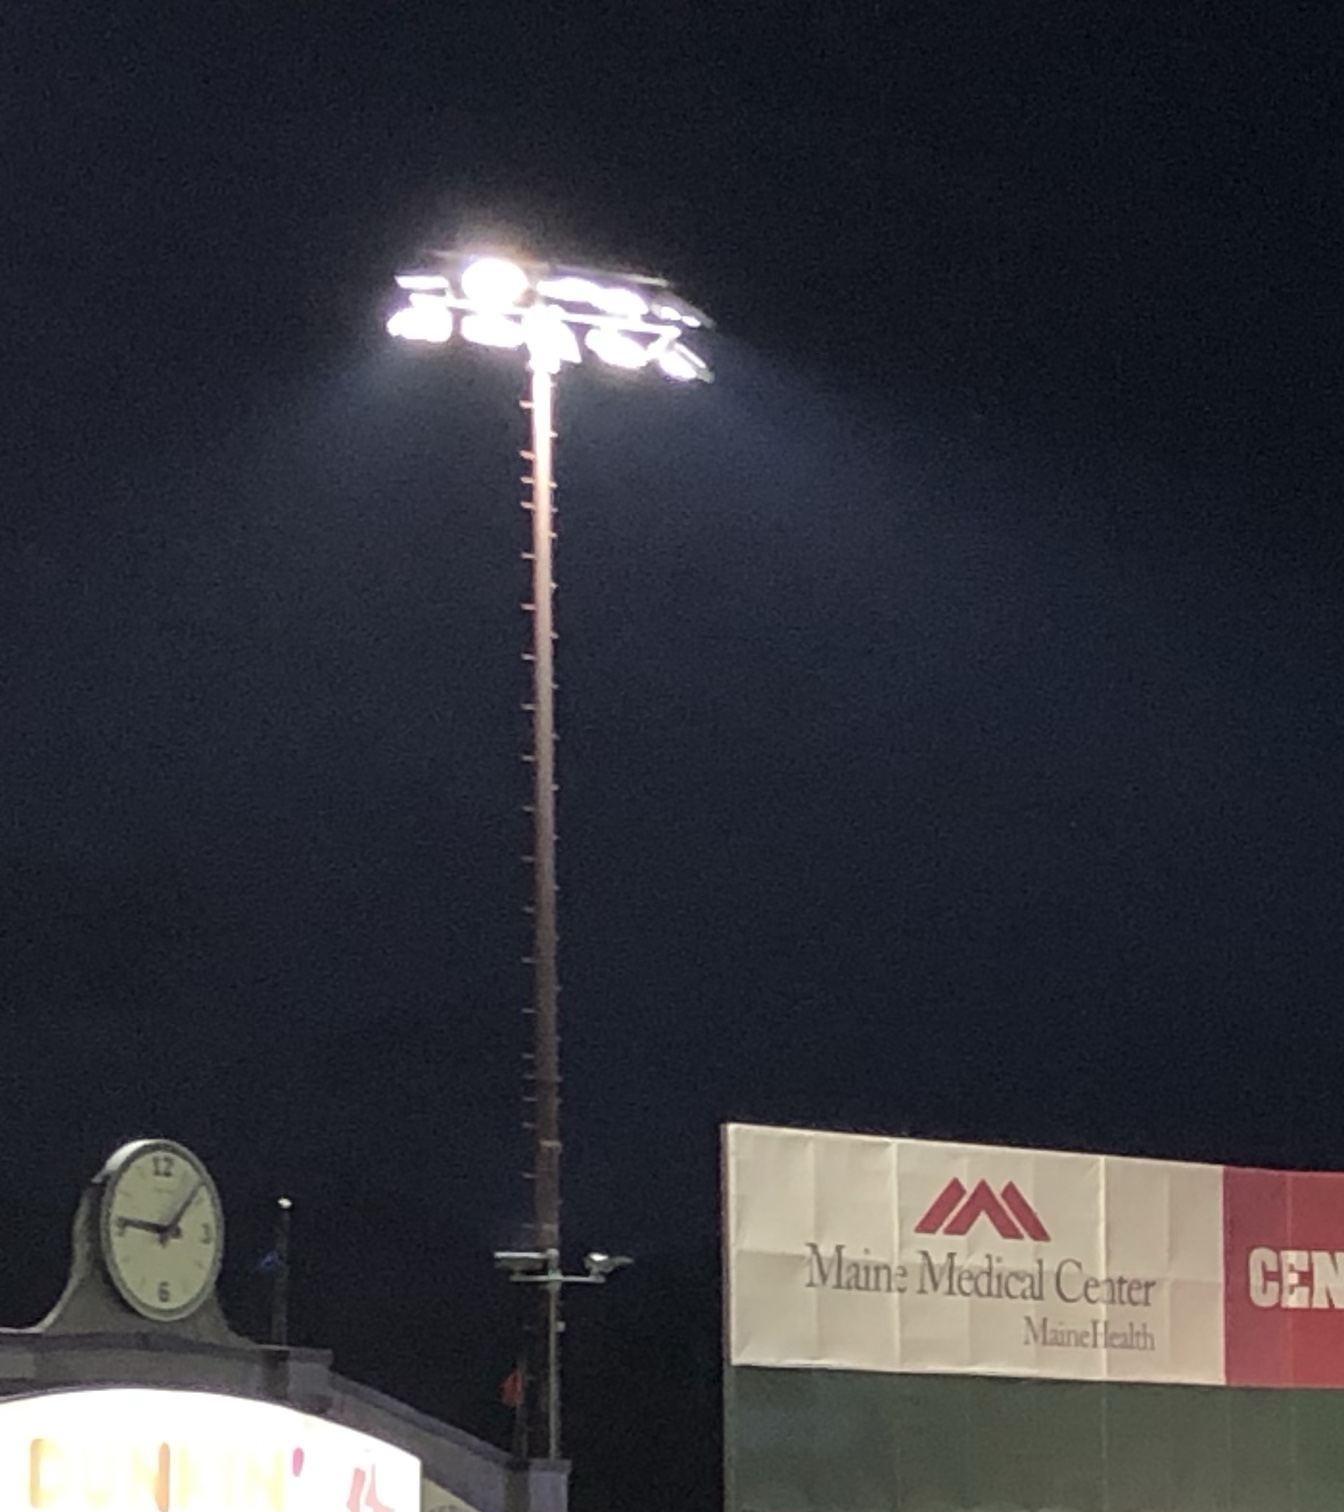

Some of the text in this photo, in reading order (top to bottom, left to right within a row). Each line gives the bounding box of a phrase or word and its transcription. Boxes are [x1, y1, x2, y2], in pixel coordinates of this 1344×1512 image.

[152, 1156, 174, 1177] 12
[804, 1243, 1157, 1309] Maine Medical Center
[157, 1280, 170, 1303] 6
[1023, 1315, 1157, 1351] MaineHealth
